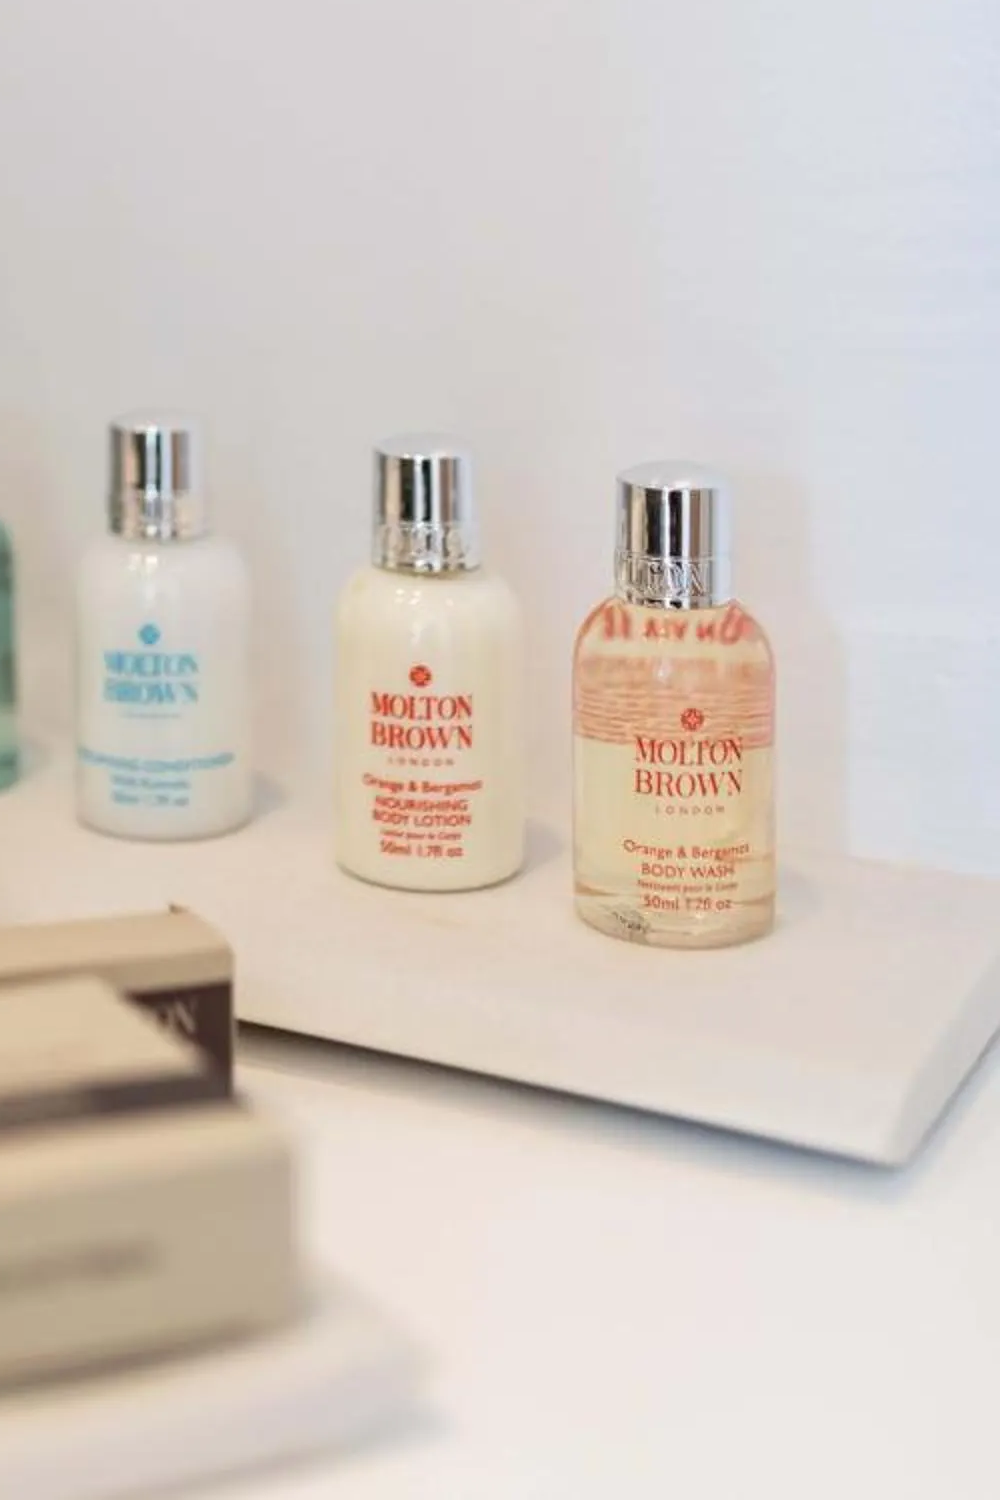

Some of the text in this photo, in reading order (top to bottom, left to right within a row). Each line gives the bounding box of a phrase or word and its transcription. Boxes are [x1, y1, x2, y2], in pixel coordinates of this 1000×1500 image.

[370, 691, 473, 720] MOLTON
[370, 721, 473, 750] BROWN
[634, 736, 744, 766] MOLTON
[388, 756, 455, 768] LONDON
[362, 772, 403, 794] Orange
[408, 781, 418, 792] &
[634, 768, 744, 797] BROWN
[375, 795, 468, 812] NOURISHING
[655, 805, 725, 816] LONDON
[373, 809, 471, 827] BODY LOTION
[623, 839, 672, 860] Orange
[677, 845, 687, 859] &
[641, 862, 735, 879] BODY WASH
[643, 895, 679, 911] 50ml
